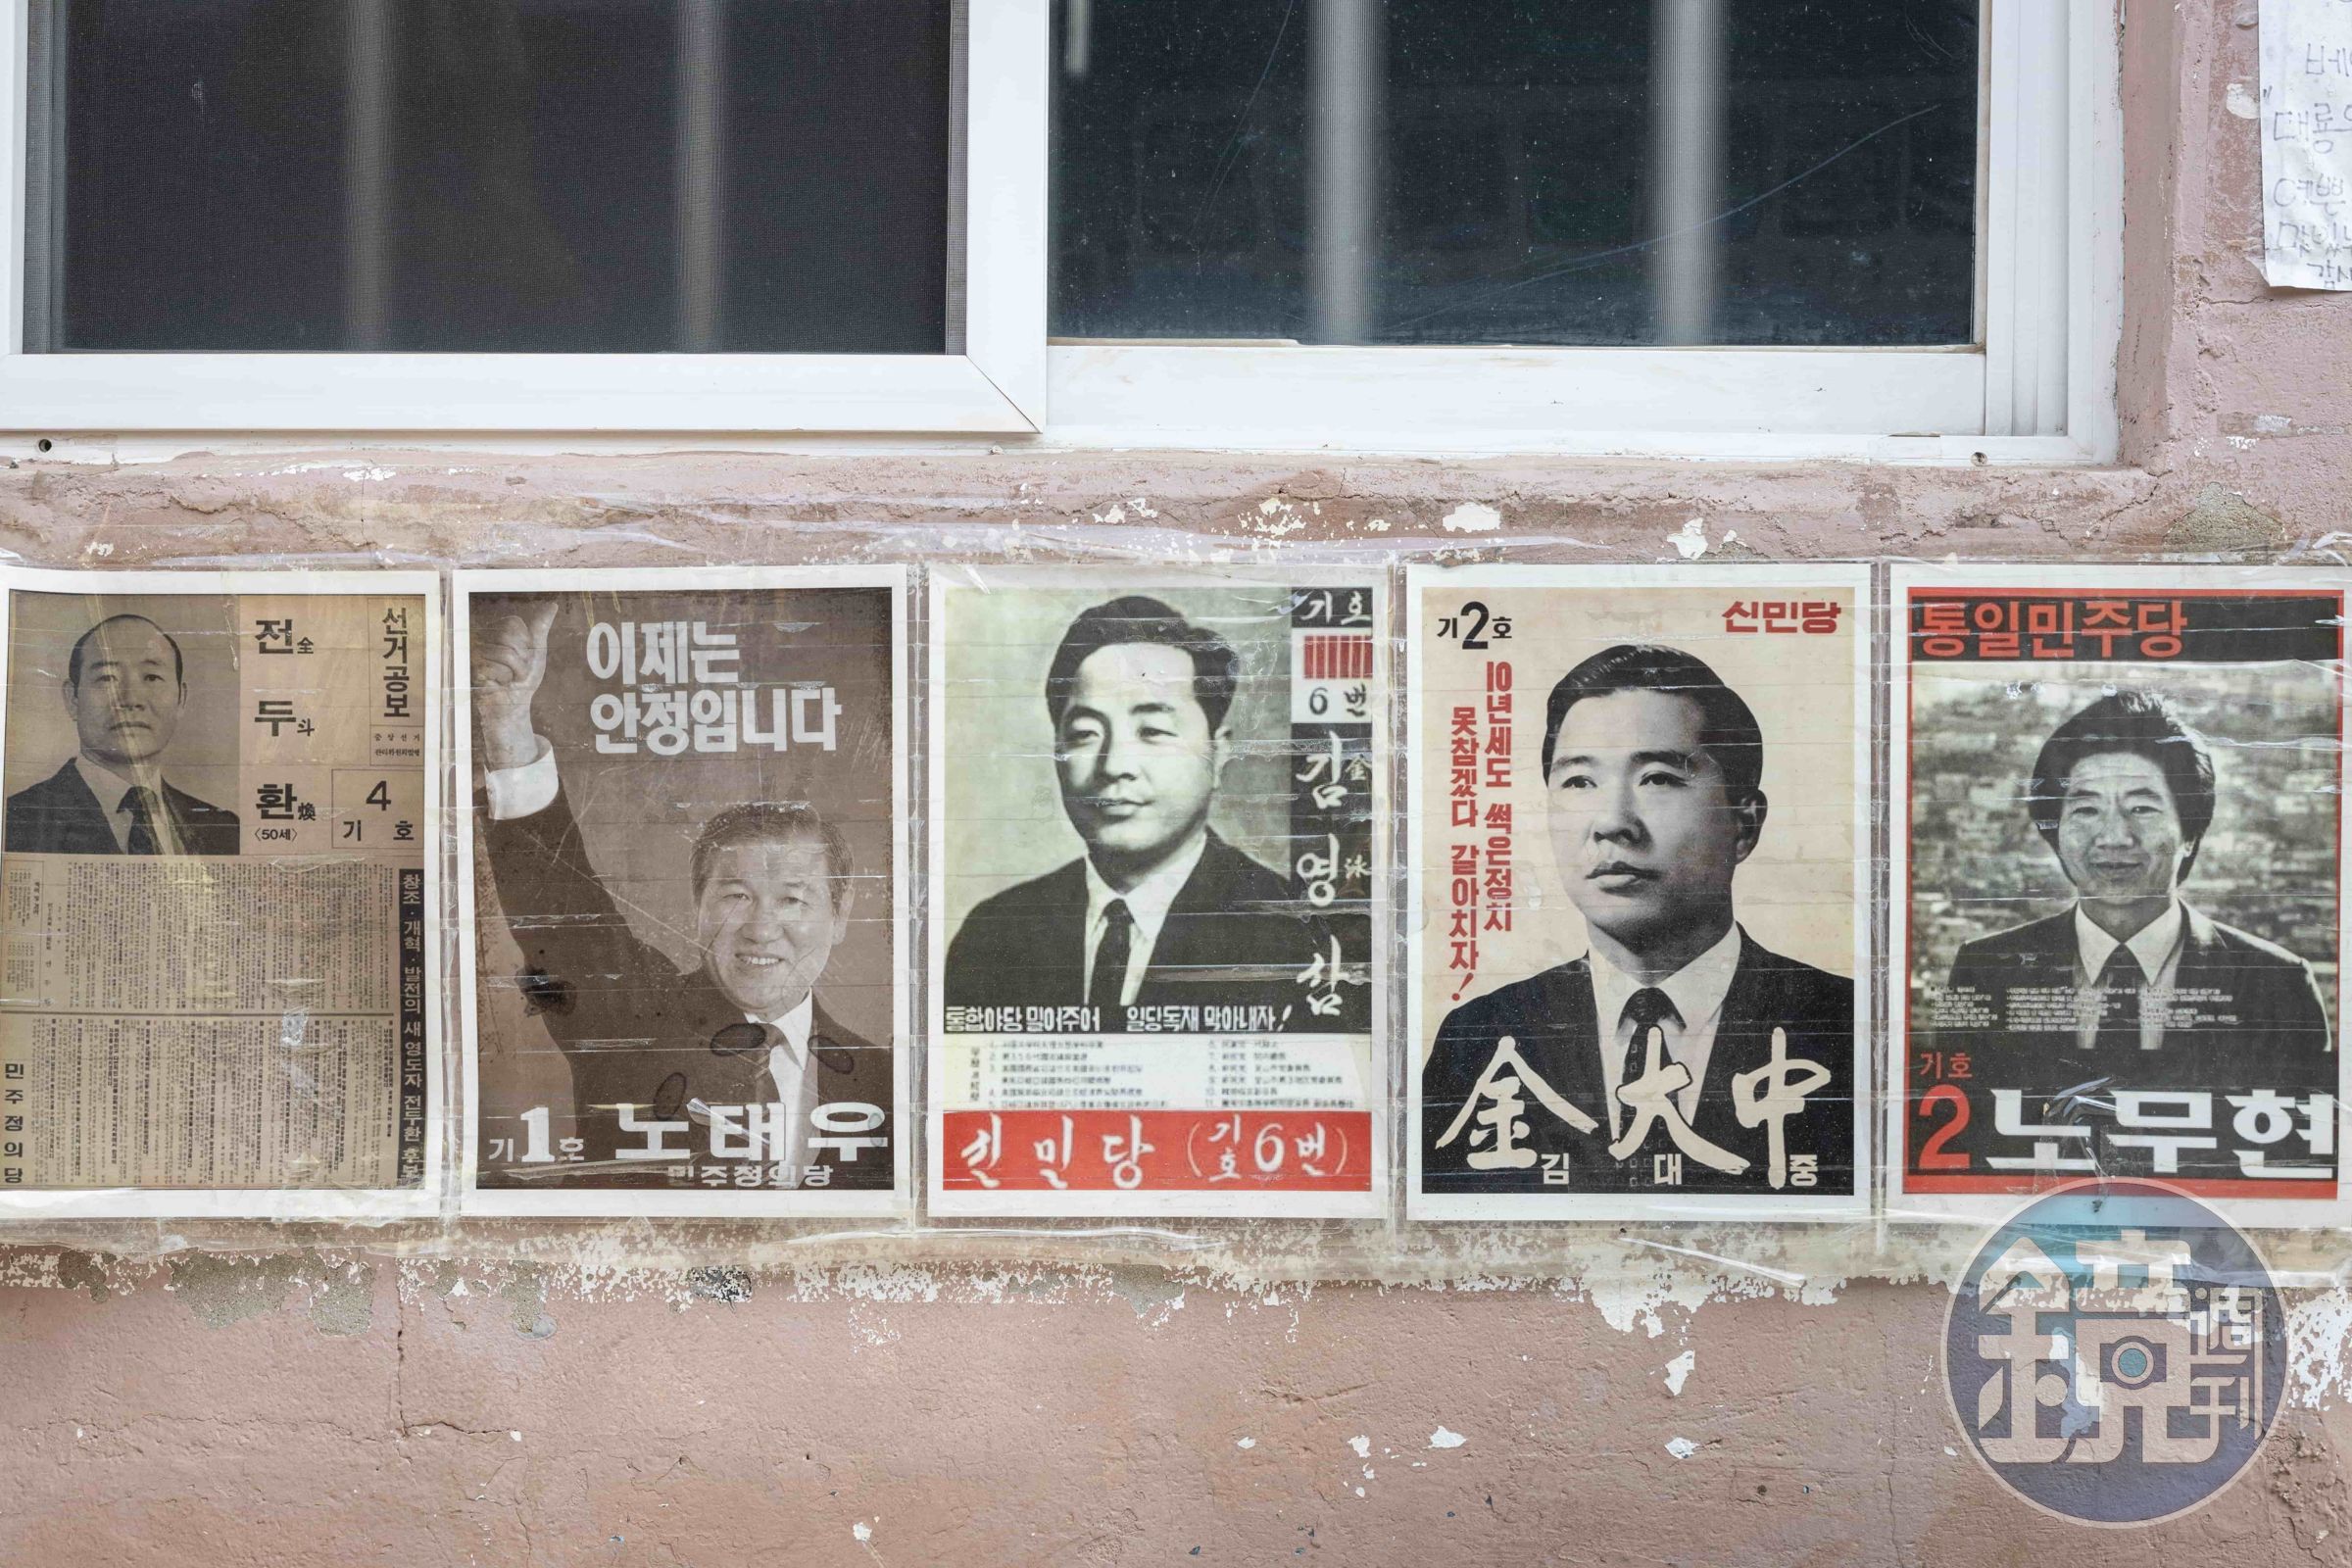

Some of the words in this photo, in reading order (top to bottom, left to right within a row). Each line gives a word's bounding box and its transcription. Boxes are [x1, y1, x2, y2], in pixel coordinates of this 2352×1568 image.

[1300, 590, 1371, 625] 기호
[1722, 601, 1841, 634] 신민당
[1919, 600, 2187, 659] 통일민주당
[382, 607, 410, 718] 선거공보
[586, 621, 741, 685] 이제는
[590, 687, 842, 757] 안정입니다
[366, 780, 391, 812] 4
[1450, 707, 1479, 827] 못참겠다
[1484, 803, 1512, 932] 썩은정치
[946, 1005, 1022, 1032] 통합야당
[1127, 1005, 1200, 1032] 일당독재
[1920, 1052, 1973, 1079] 기호
[4, 1062, 24, 1184] 민주정의당
[403, 1094, 422, 1142] 전두환
[615, 1102, 889, 1162] 노태우
[1436, 1026, 1832, 1190] 金大中
[1918, 1085, 1971, 1169] 2
[1985, 1088, 2335, 1179] 노무현
[960, 1113, 1155, 1189] 신민당
